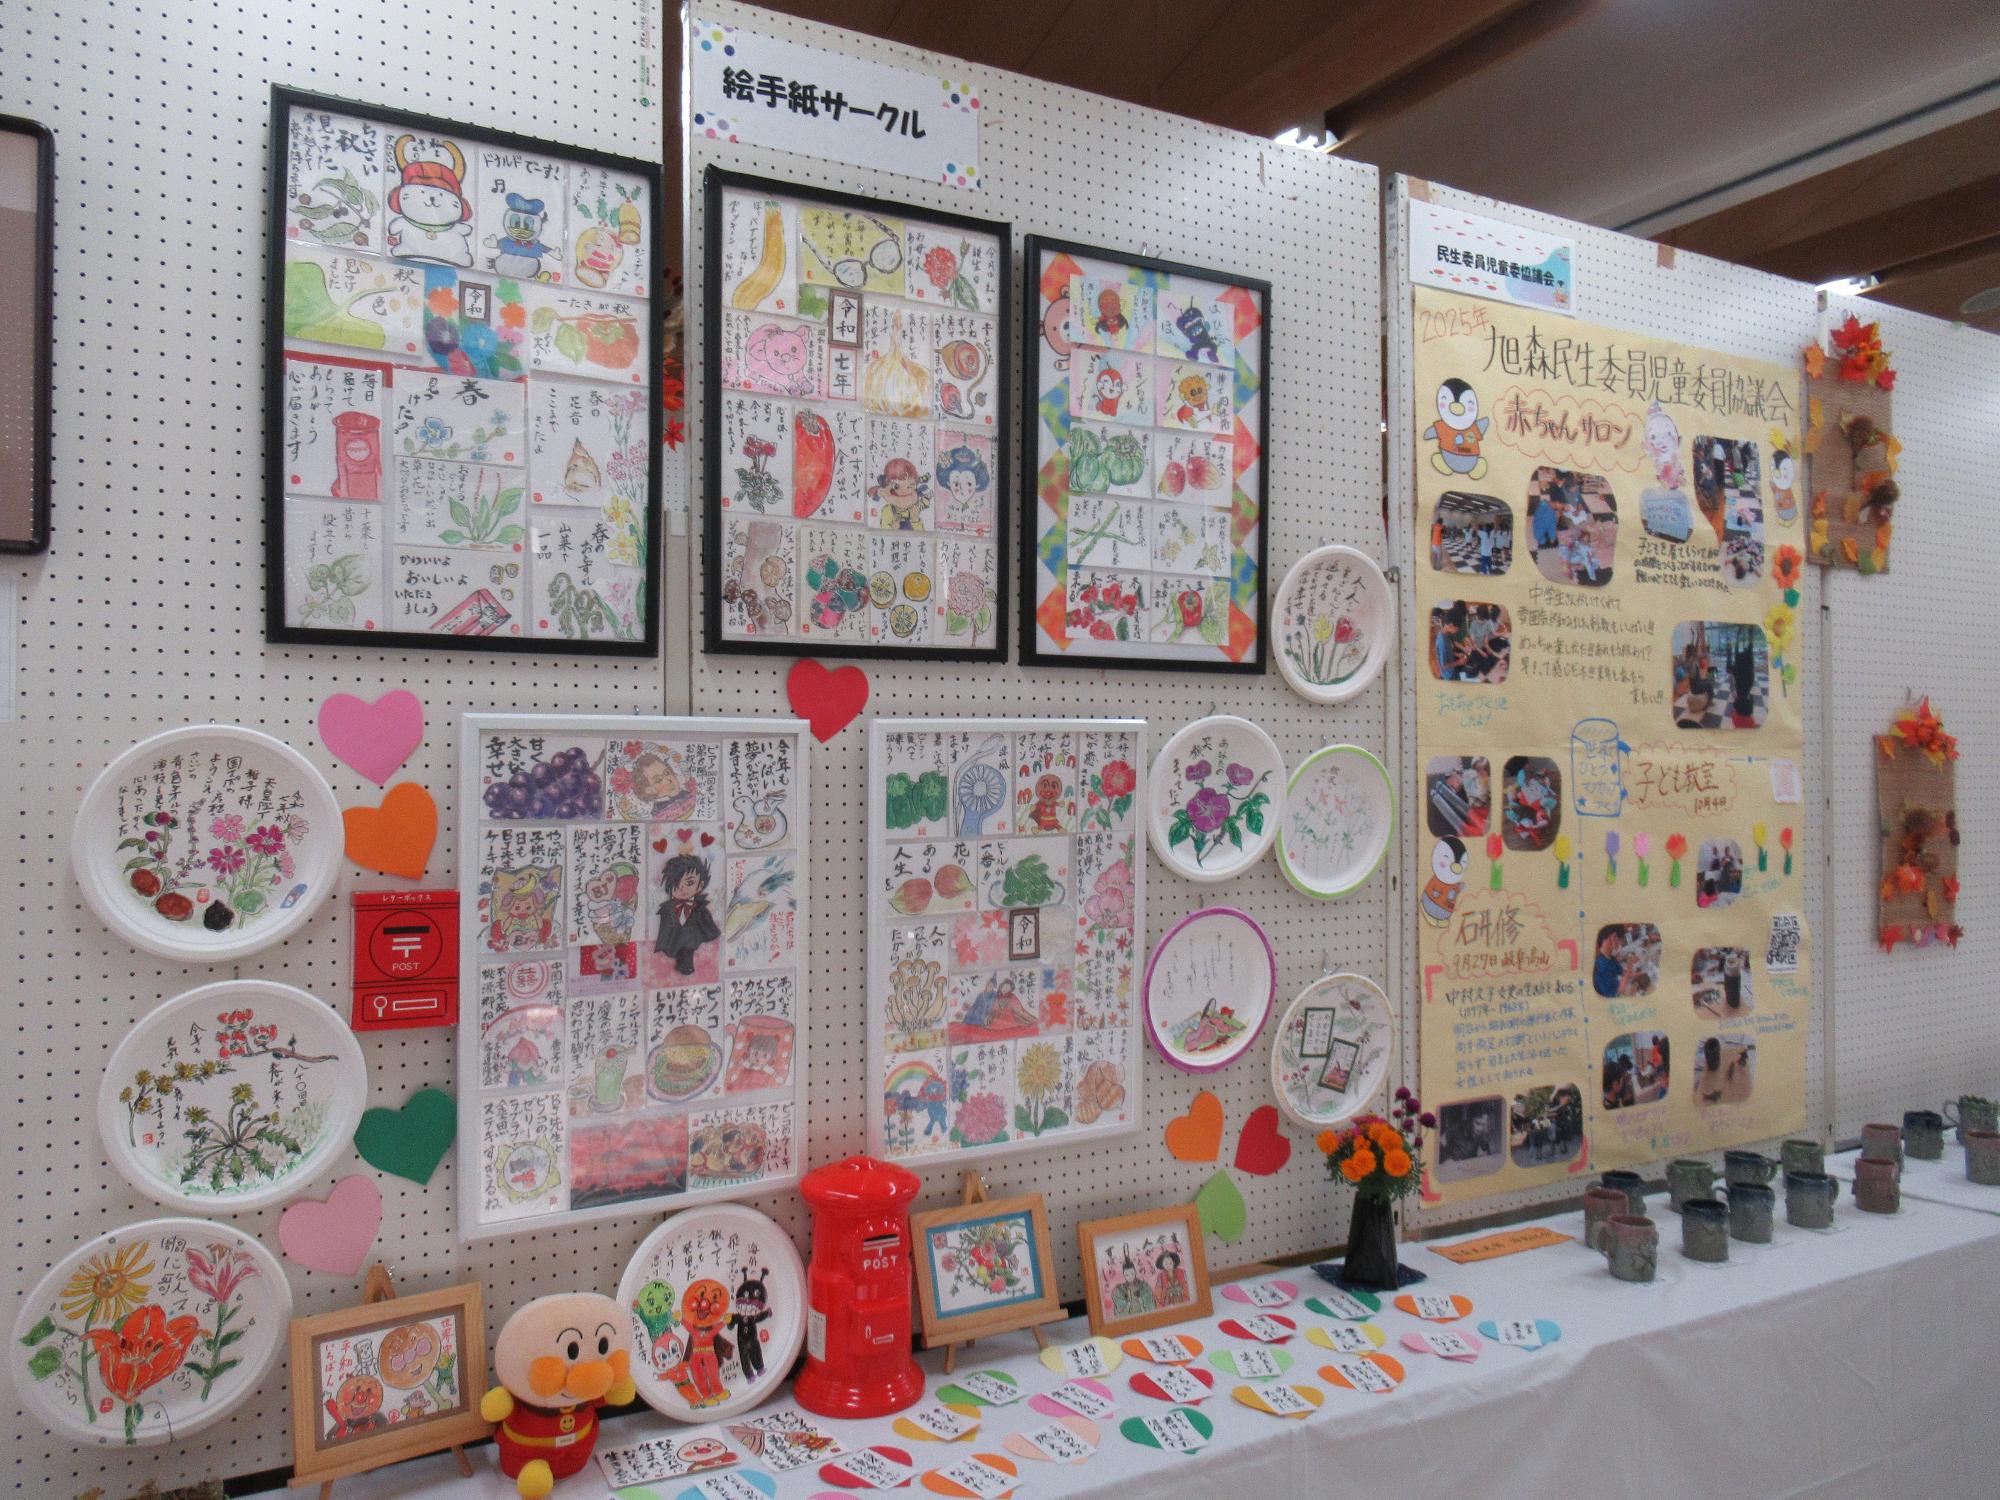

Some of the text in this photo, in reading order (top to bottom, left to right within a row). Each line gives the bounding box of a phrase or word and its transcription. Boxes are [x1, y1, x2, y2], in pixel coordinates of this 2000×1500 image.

[722, 65, 927, 140] 絵手紙サークル
[1436, 244, 1555, 288] 民生委員児童委協議会
[466, 288, 483, 314] 令和
[838, 299, 856, 334] 令和
[1419, 305, 1490, 344] 2025年
[362, 373, 378, 402] 毎日
[455, 378, 490, 406] 春
[833, 353, 852, 395] 七年
[1483, 324, 1794, 427] 旭森民生委員児童委員協議会
[1503, 393, 1633, 449] 赤ちゃんサロン
[399, 555, 452, 566] かわいいよ
[405, 569, 468, 586] おいしいよ
[403, 603, 438, 616] ましょう
[485, 736, 506, 778] 幸せ
[507, 736, 527, 775] 大きな
[529, 736, 545, 763] 甘く
[761, 741, 777, 789] いっぱい
[775, 738, 791, 786] 今年も
[729, 740, 742, 797] ますように
[1635, 761, 1720, 804] 子ども教室
[530, 829, 546, 863] 子供の
[892, 846, 914, 878] 人生
[381, 893, 433, 903] レターボックス
[1015, 915, 1033, 950] 令和
[1455, 907, 1526, 948] 研修
[392, 962, 421, 972] POST
[706, 986, 721, 1029] ピノコ
[863, 1255, 898, 1271] POST
